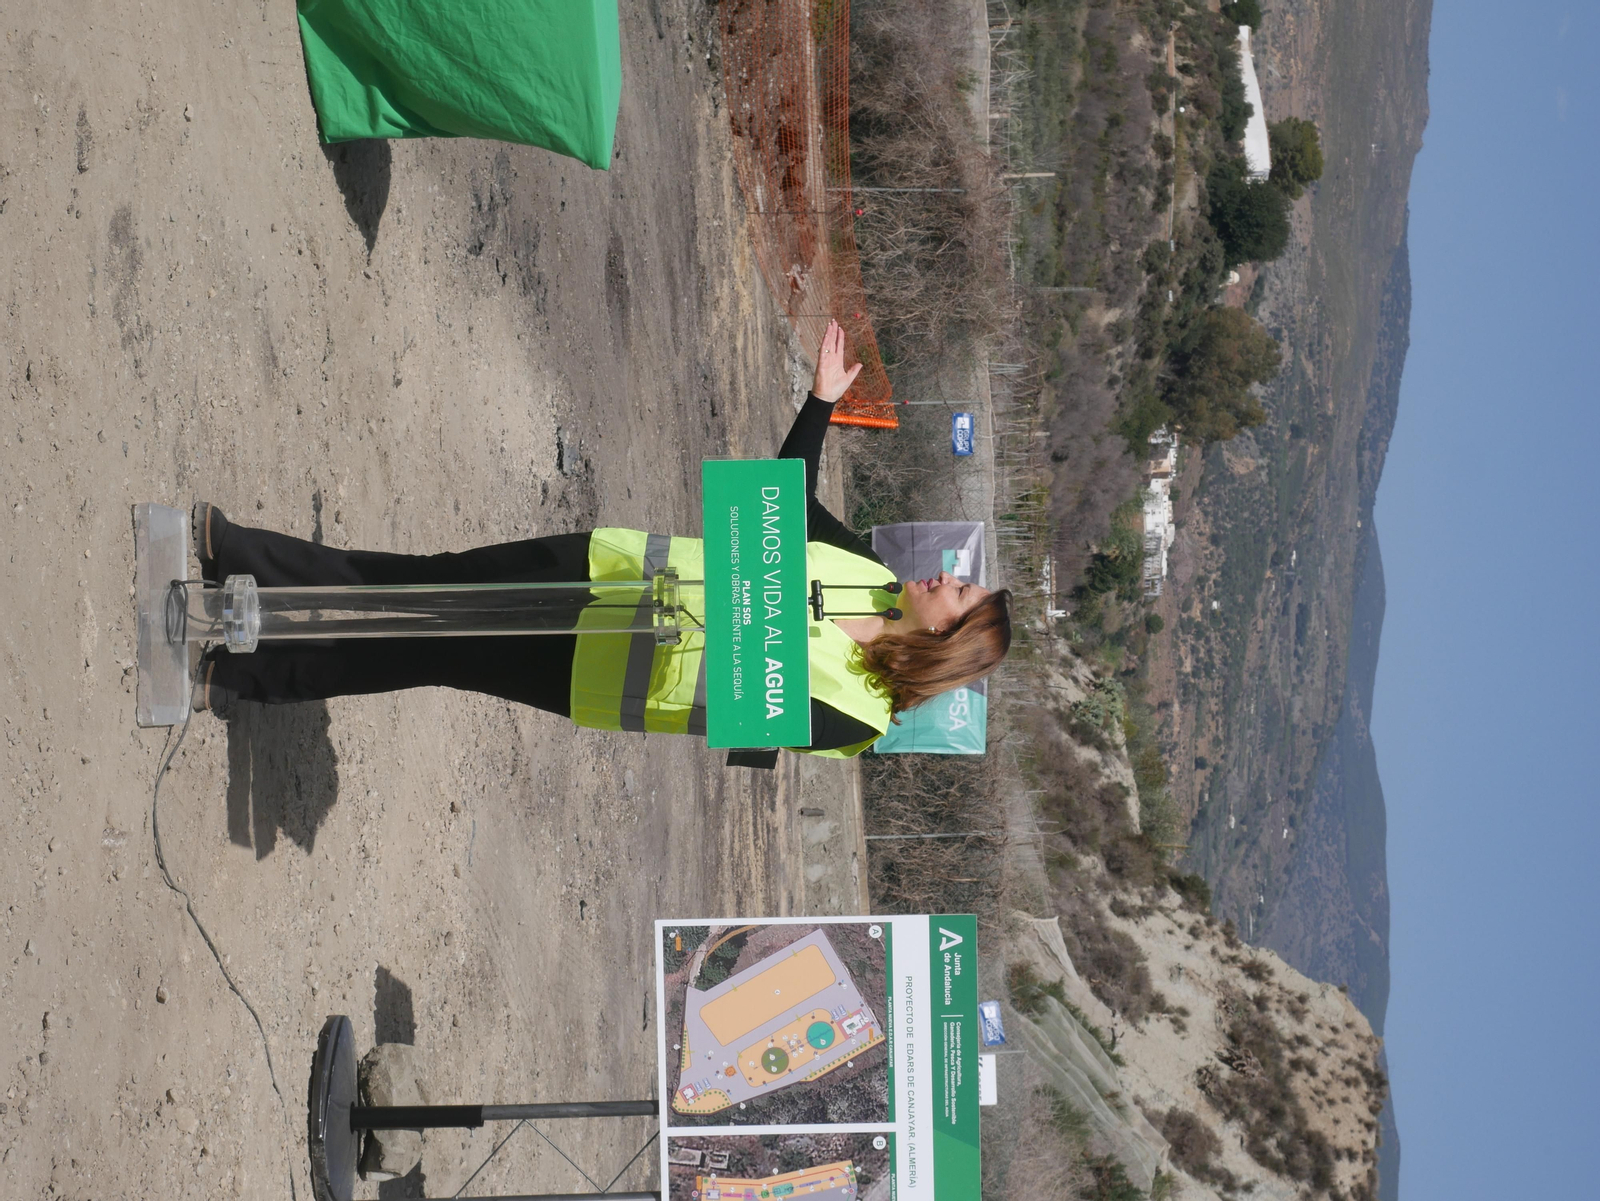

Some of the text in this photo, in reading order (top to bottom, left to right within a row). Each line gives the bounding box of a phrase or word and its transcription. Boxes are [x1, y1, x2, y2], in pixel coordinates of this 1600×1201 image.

[730, 506, 739, 564] SOLUCIONES
[732, 574, 740, 604] OBRAS
[762, 486, 784, 719] DAMOS VIDA AL AGUA
[732, 607, 741, 642] FRENTE
[743, 607, 751, 625] SOS
[733, 653, 741, 665] LA
[733, 667, 744, 700] SEQUÍA
[944, 952, 952, 1005] de Andalucía
[907, 1027, 913, 1038] DE
[907, 1076, 914, 1087] DE
[907, 1143, 918, 1188] (ALMERÍA)
